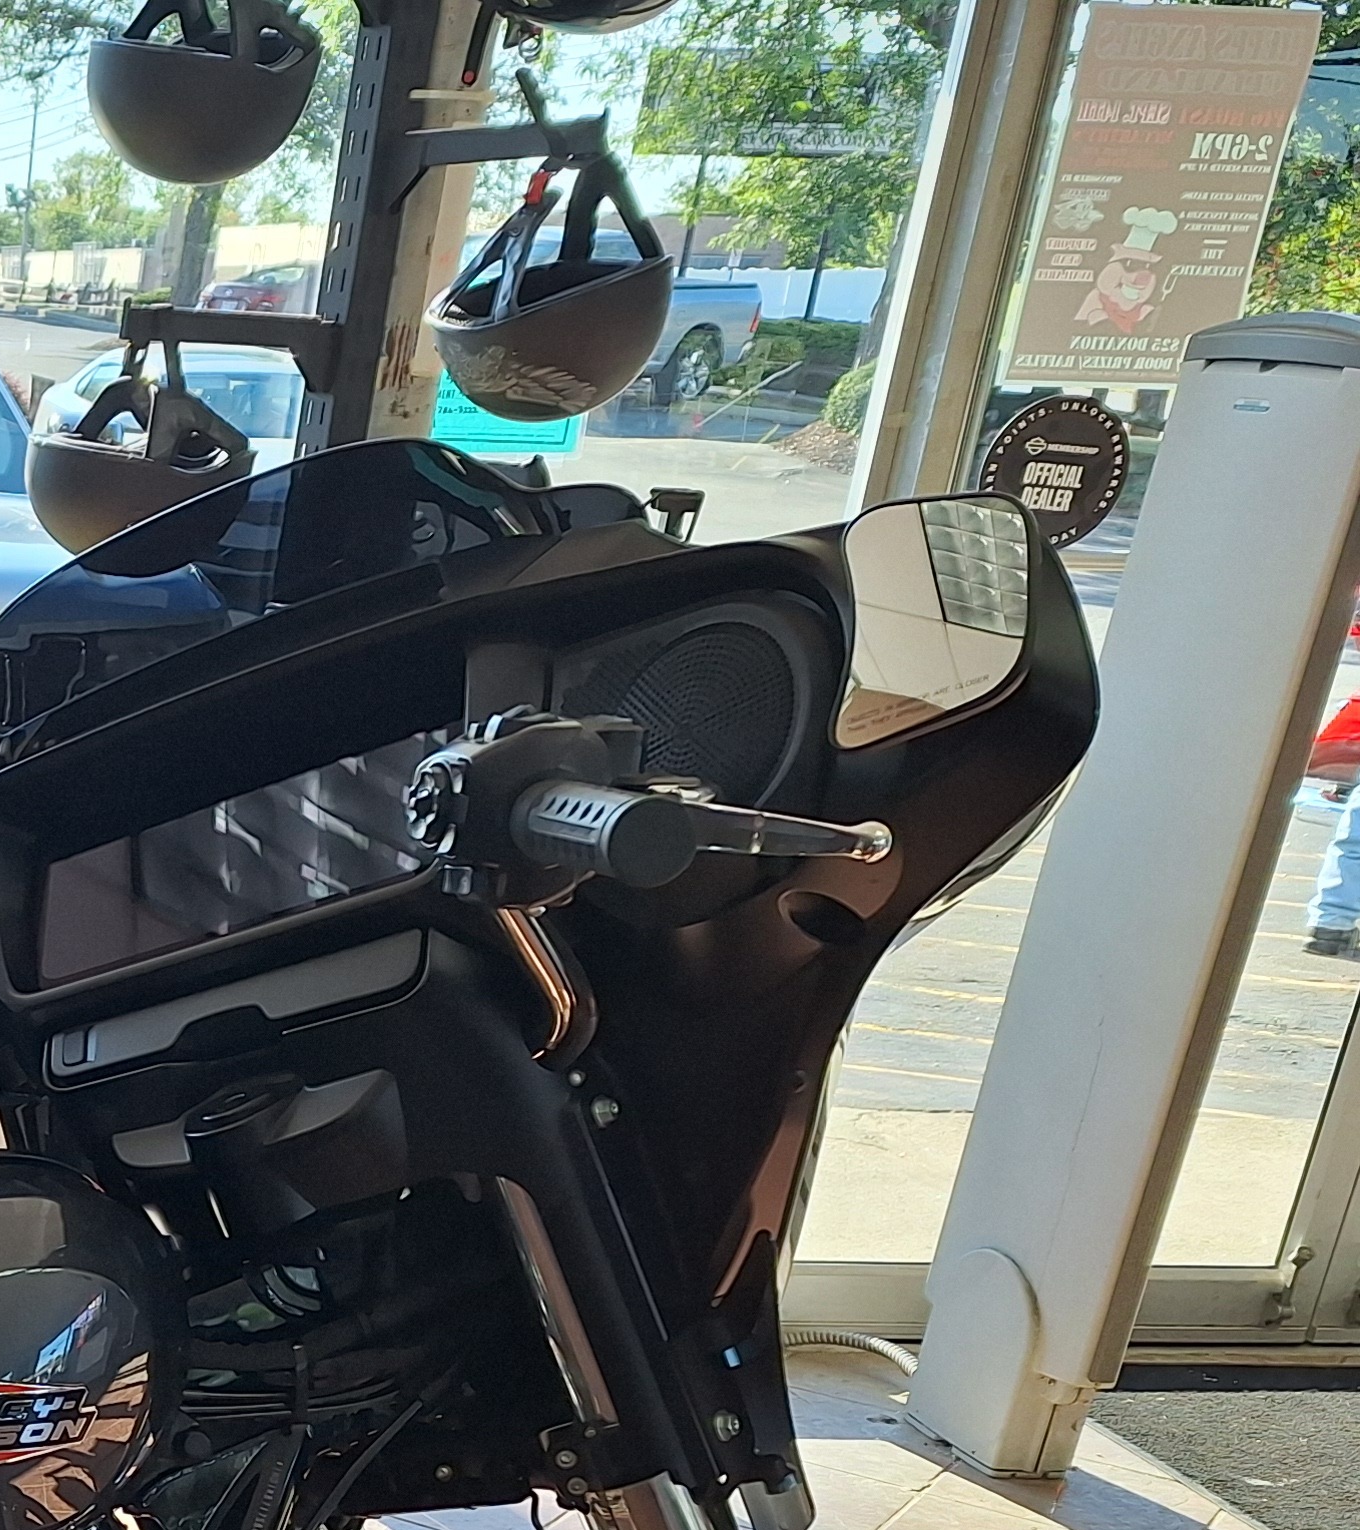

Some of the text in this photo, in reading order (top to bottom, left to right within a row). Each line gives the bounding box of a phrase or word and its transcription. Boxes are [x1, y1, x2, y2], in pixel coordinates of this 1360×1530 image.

[985, 463, 998, 491] ARN
[1061, 402, 1115, 429] UNLOCK
[1023, 461, 1084, 489] OFFICIAL
[1020, 486, 1074, 512] DEALER
